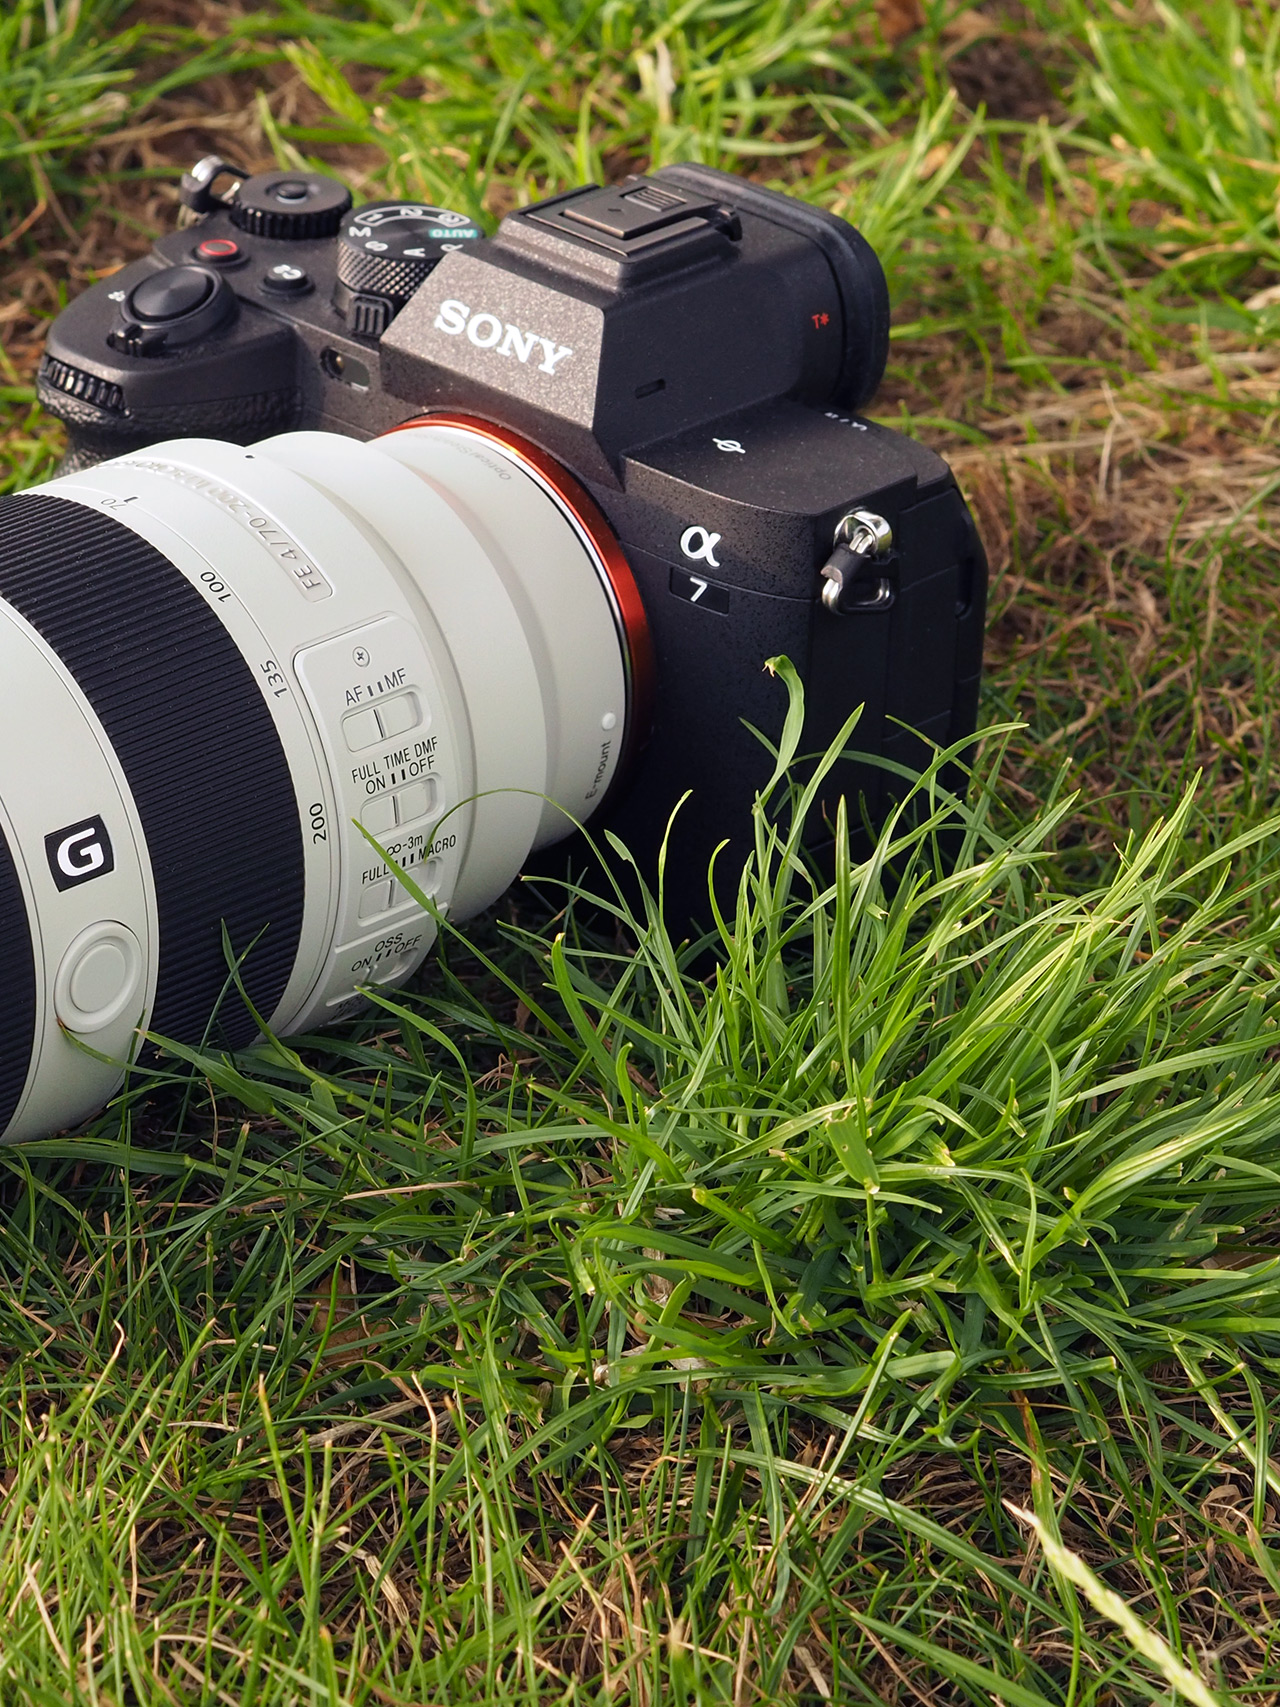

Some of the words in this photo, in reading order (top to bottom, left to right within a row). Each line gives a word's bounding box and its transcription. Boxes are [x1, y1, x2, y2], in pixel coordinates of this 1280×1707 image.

[400, 207, 423, 217] 2
[349, 227, 372, 237] M
[364, 241, 388, 251] S
[432, 229, 475, 238] AUTO
[403, 247, 426, 257] A
[434, 299, 573, 376] SONY
[101, 498, 126, 510] 70
[680, 526, 721, 567] α
[200, 571, 232, 603] 100
[293, 564, 321, 591] FE
[690, 576, 707, 602] 7
[261, 660, 288, 698] 135
[345, 685, 363, 706] AF
[384, 668, 407, 690] MF
[352, 761, 381, 783] FULL
[383, 747, 411, 770] TIME
[414, 736, 438, 758] DMF
[365, 775, 386, 795] ON
[409, 755, 435, 776] OFF
[584, 739, 612, 800] E-mount
[309, 802, 326, 844] 200
[57, 828, 104, 877] G
[362, 863, 390, 885] FULL
[351, 955, 373, 972] ON
[394, 934, 423, 954] OFF
[374, 932, 404, 953] OSS
